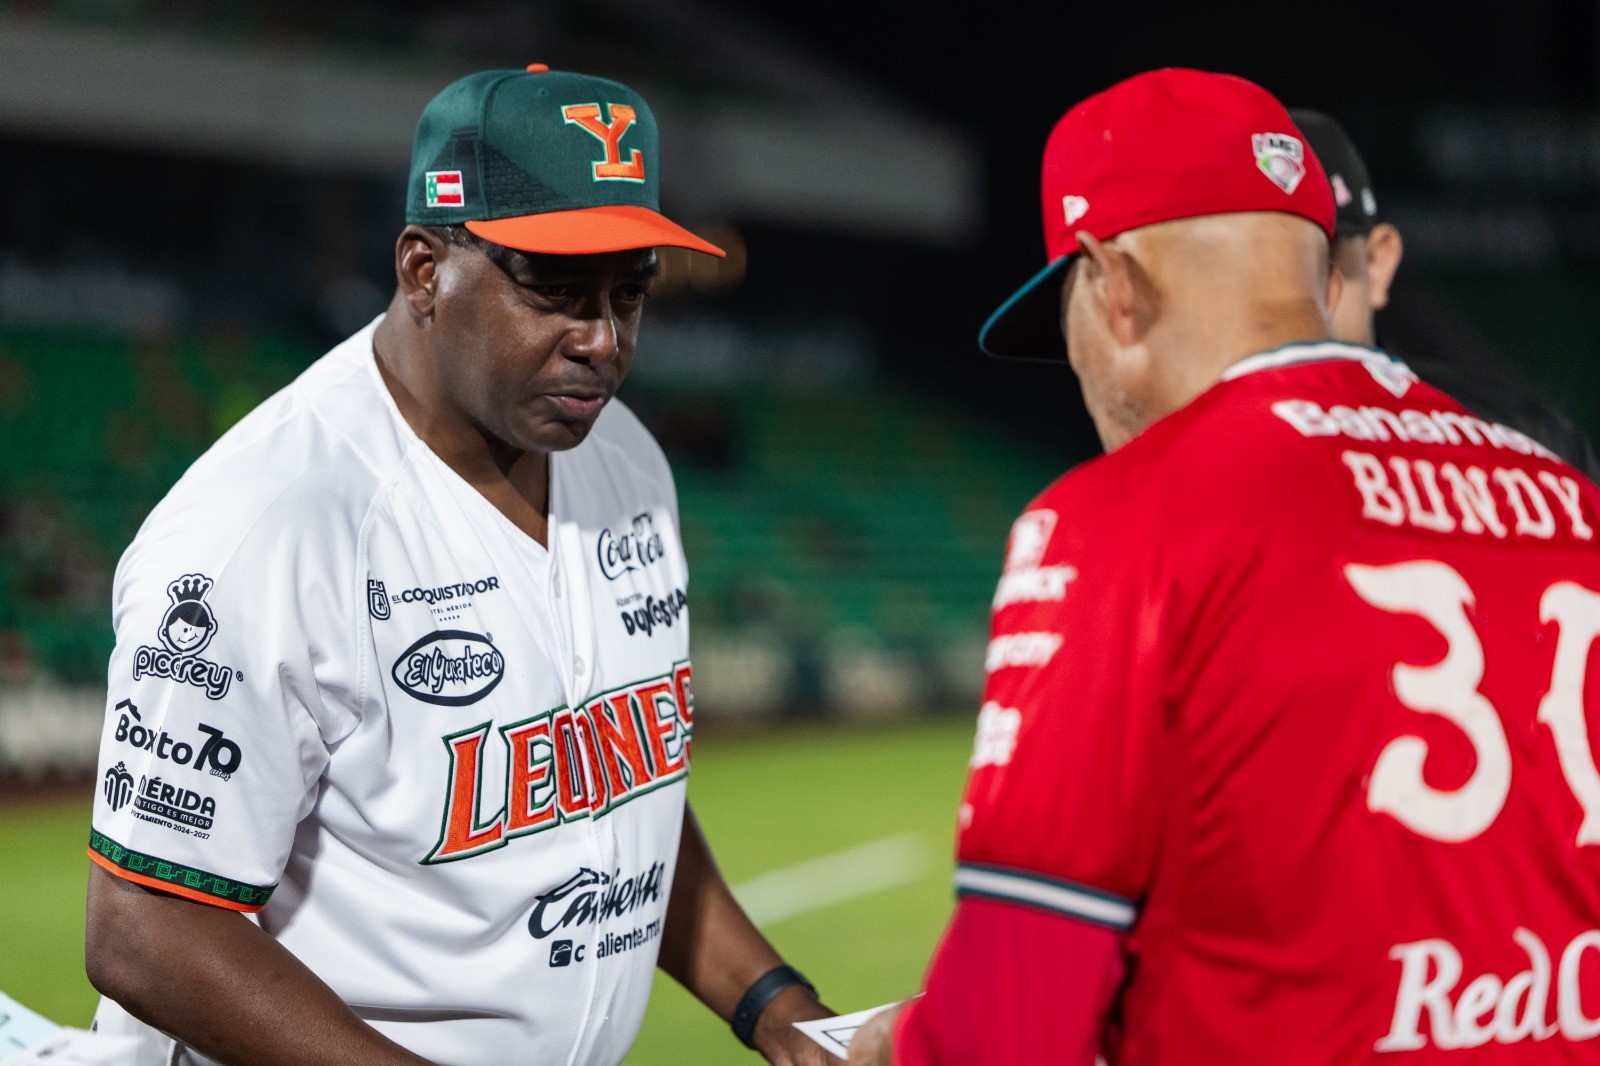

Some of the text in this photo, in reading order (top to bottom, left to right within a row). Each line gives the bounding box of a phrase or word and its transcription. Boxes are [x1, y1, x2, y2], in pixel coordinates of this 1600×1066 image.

[1341, 450, 1593, 540] BUNDY
[391, 576, 500, 605] EL COQUISTADOR
[114, 711, 242, 772] Boxto 70
[418, 658, 694, 865] LEONES
[166, 808, 177, 818] ES
[179, 814, 211, 829] MEJOR
[173, 824, 211, 840] 2024-2027
[574, 918, 660, 962] caliente.m
